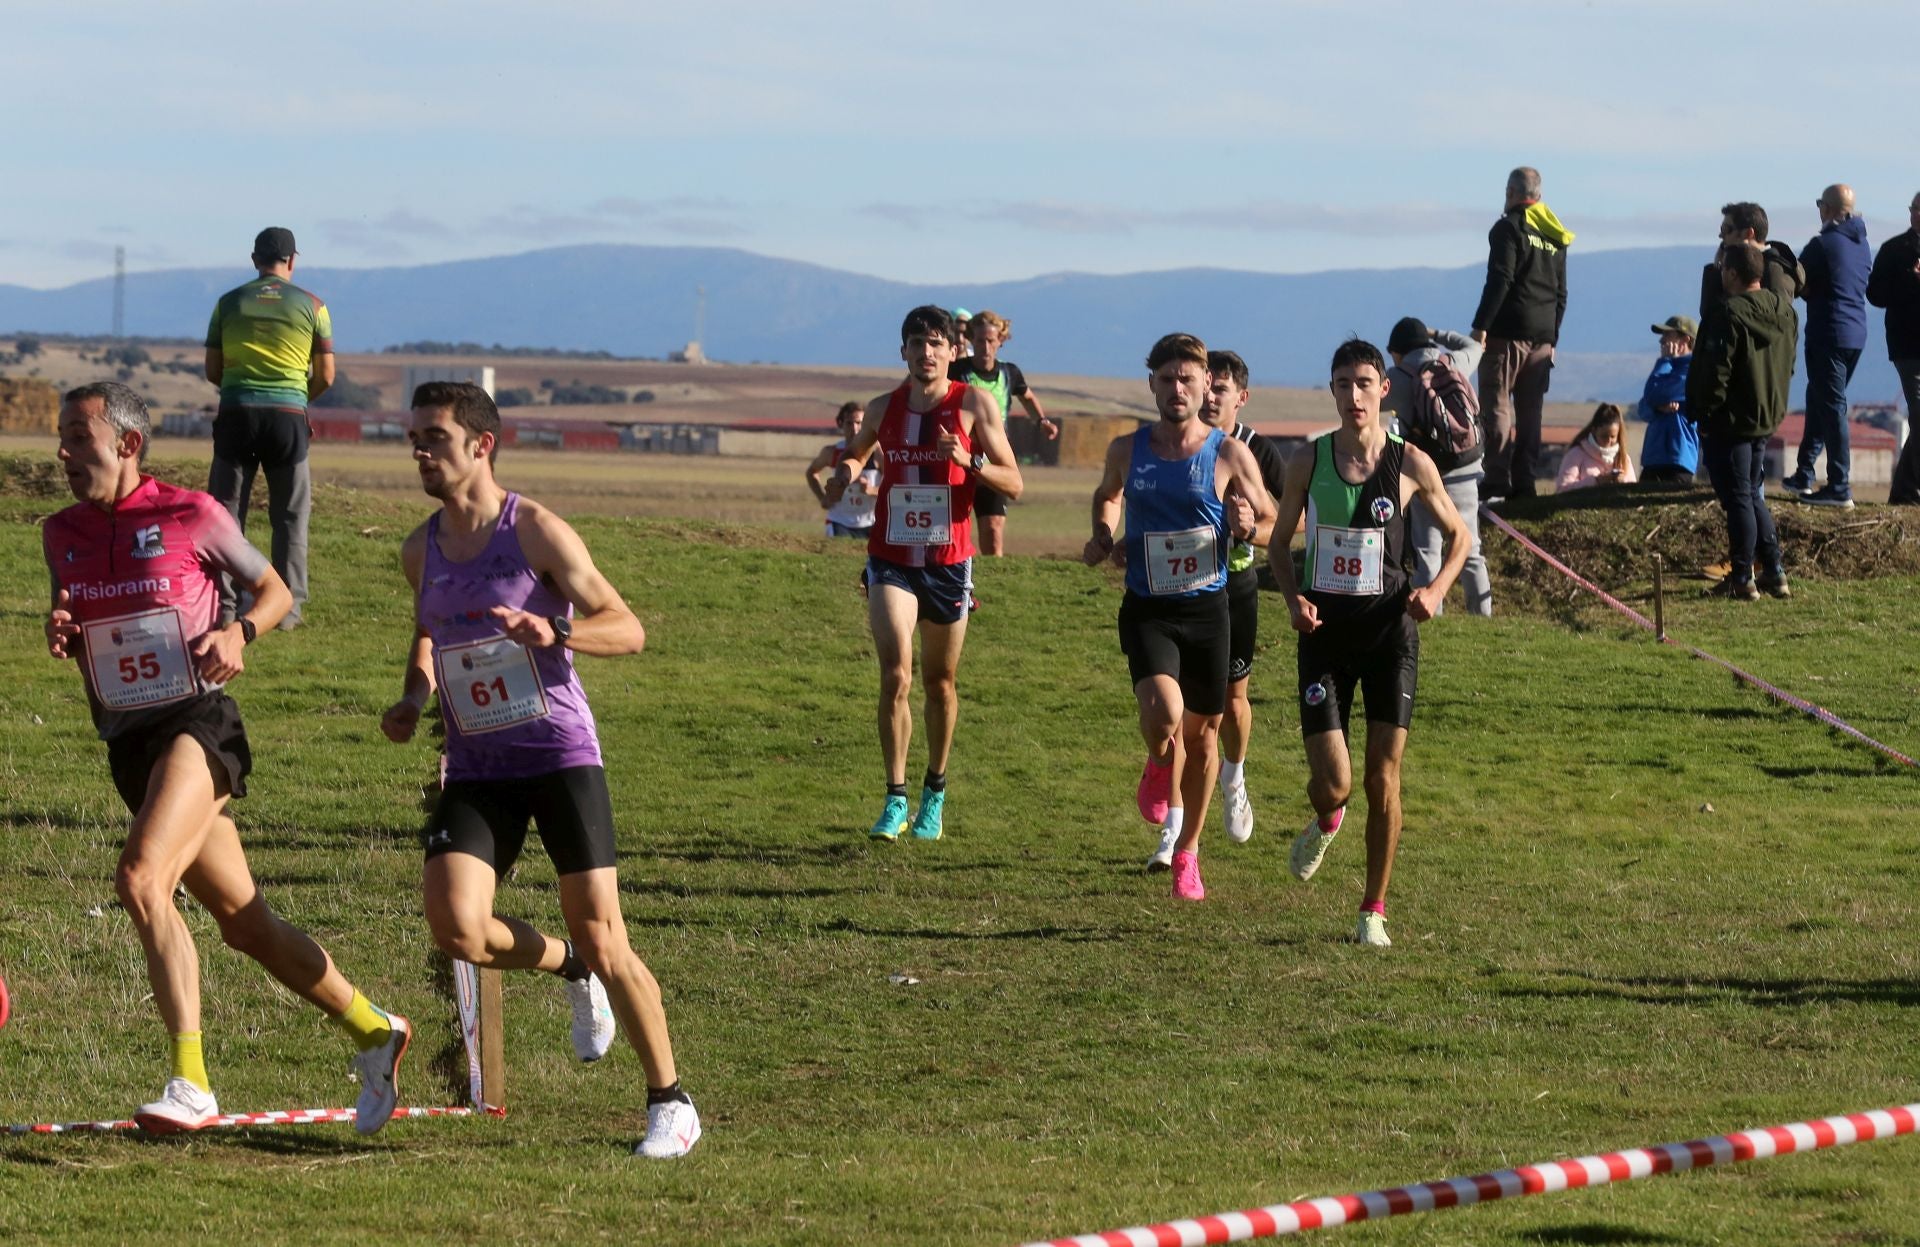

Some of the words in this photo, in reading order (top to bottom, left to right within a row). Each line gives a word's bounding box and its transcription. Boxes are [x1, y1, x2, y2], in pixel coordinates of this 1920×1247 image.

[905, 511, 932, 528] 65
[1168, 556, 1198, 576] 78
[1333, 556, 1362, 576] 88
[70, 578, 171, 601] Fisiorama
[118, 652, 161, 684] 55
[471, 675, 509, 707] 61
